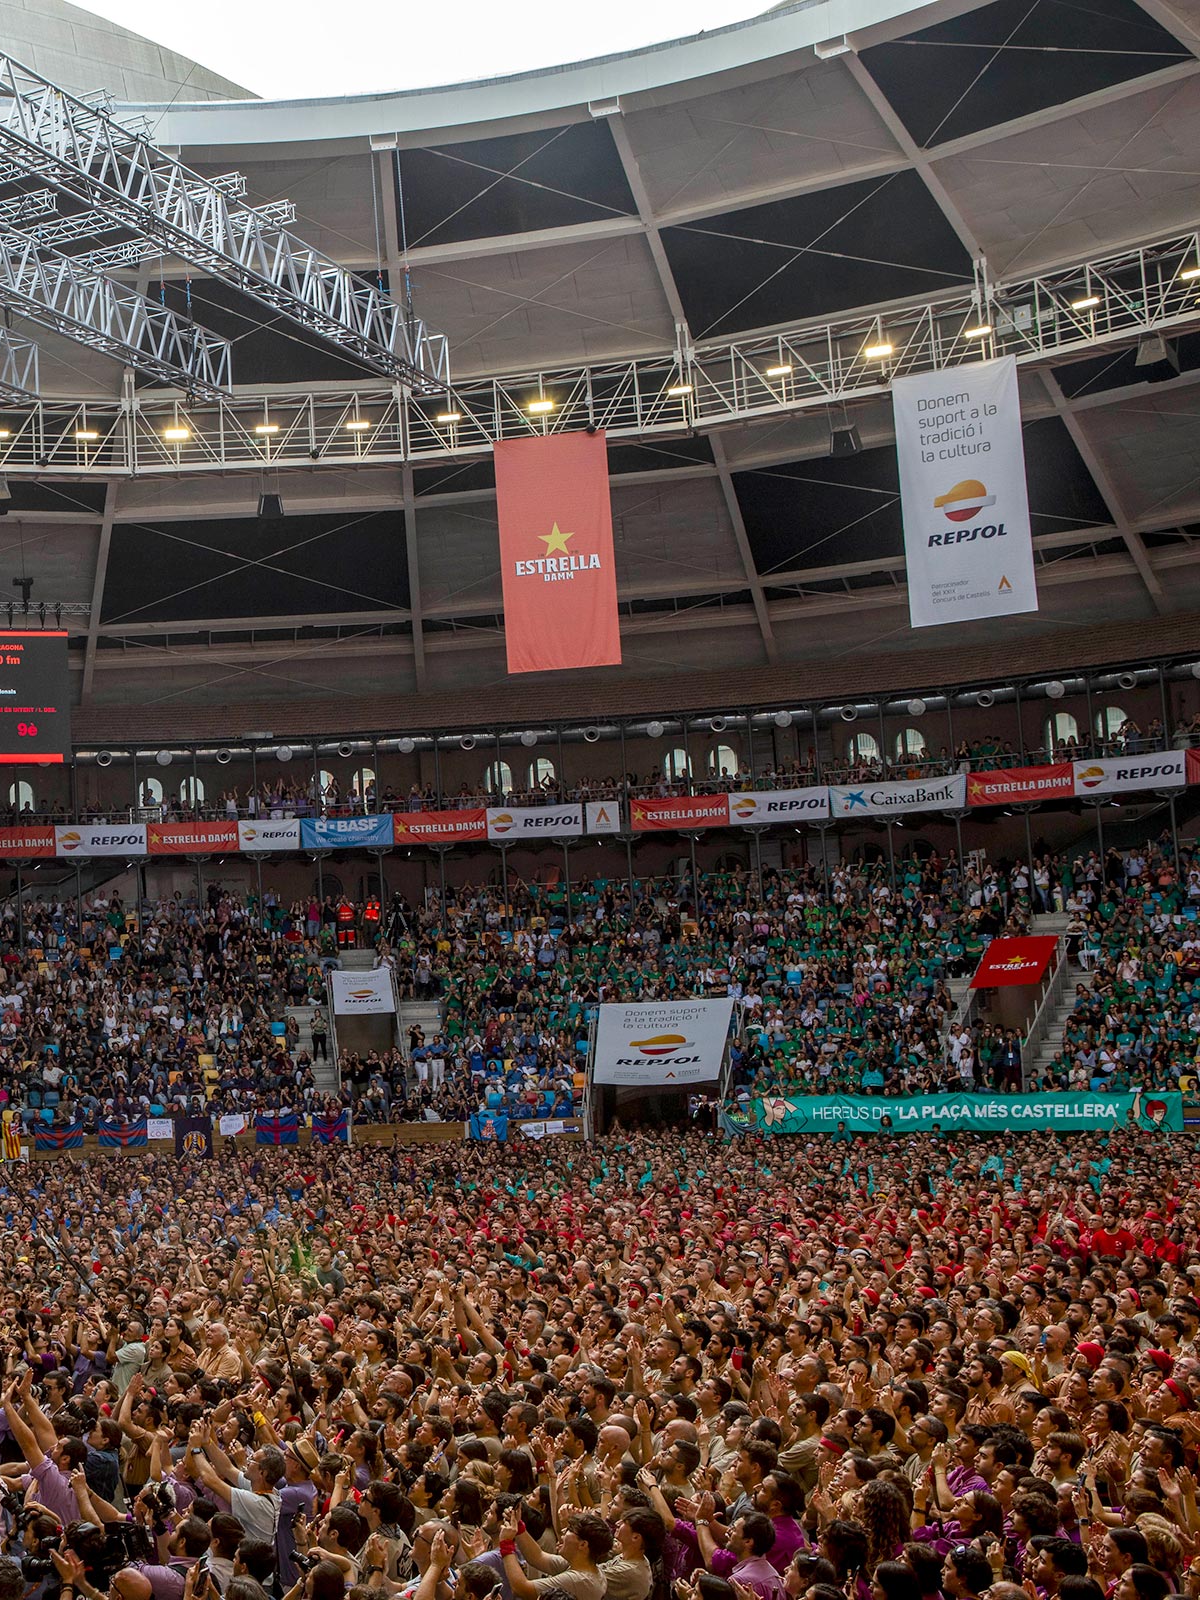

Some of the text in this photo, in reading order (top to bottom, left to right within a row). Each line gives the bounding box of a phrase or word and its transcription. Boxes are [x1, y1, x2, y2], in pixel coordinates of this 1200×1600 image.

[917, 392, 970, 412] Donem
[918, 404, 997, 428] suport a la
[920, 422, 982, 446] tradició i
[922, 442, 992, 463] la cultura
[928, 524, 1008, 548] REPSOL
[516, 554, 601, 576] ESTRELLA
[544, 572, 574, 582] DAMM
[6, 655, 20, 664] fm
[17, 722, 38, 736] 9è
[1116, 764, 1183, 780] REPSOL
[984, 777, 1072, 794] ESTRELLA DAMM
[870, 786, 954, 806] CaixaBank
[768, 798, 827, 812] REPSOL
[646, 806, 726, 820] ESTRELLA DAMM
[336, 818, 378, 832] BASF
[410, 820, 486, 834] ESTRELLA DAMM
[523, 816, 580, 828] REPSOL
[25, 838, 54, 848] DAMM
[90, 834, 144, 846] REPSOL
[162, 833, 236, 844] ESTRELLA DAMM
[349, 834, 379, 842] chemistry
[989, 961, 1038, 970] ESTRELLA
[648, 1014, 693, 1022] tradició
[670, 1007, 708, 1016] suport
[616, 1056, 702, 1066] REPSOL
[813, 1106, 870, 1120] HEREUS
[872, 1106, 892, 1120] DE
[922, 1104, 971, 1120] PLAÇA
[974, 1101, 1008, 1118] MÉS
